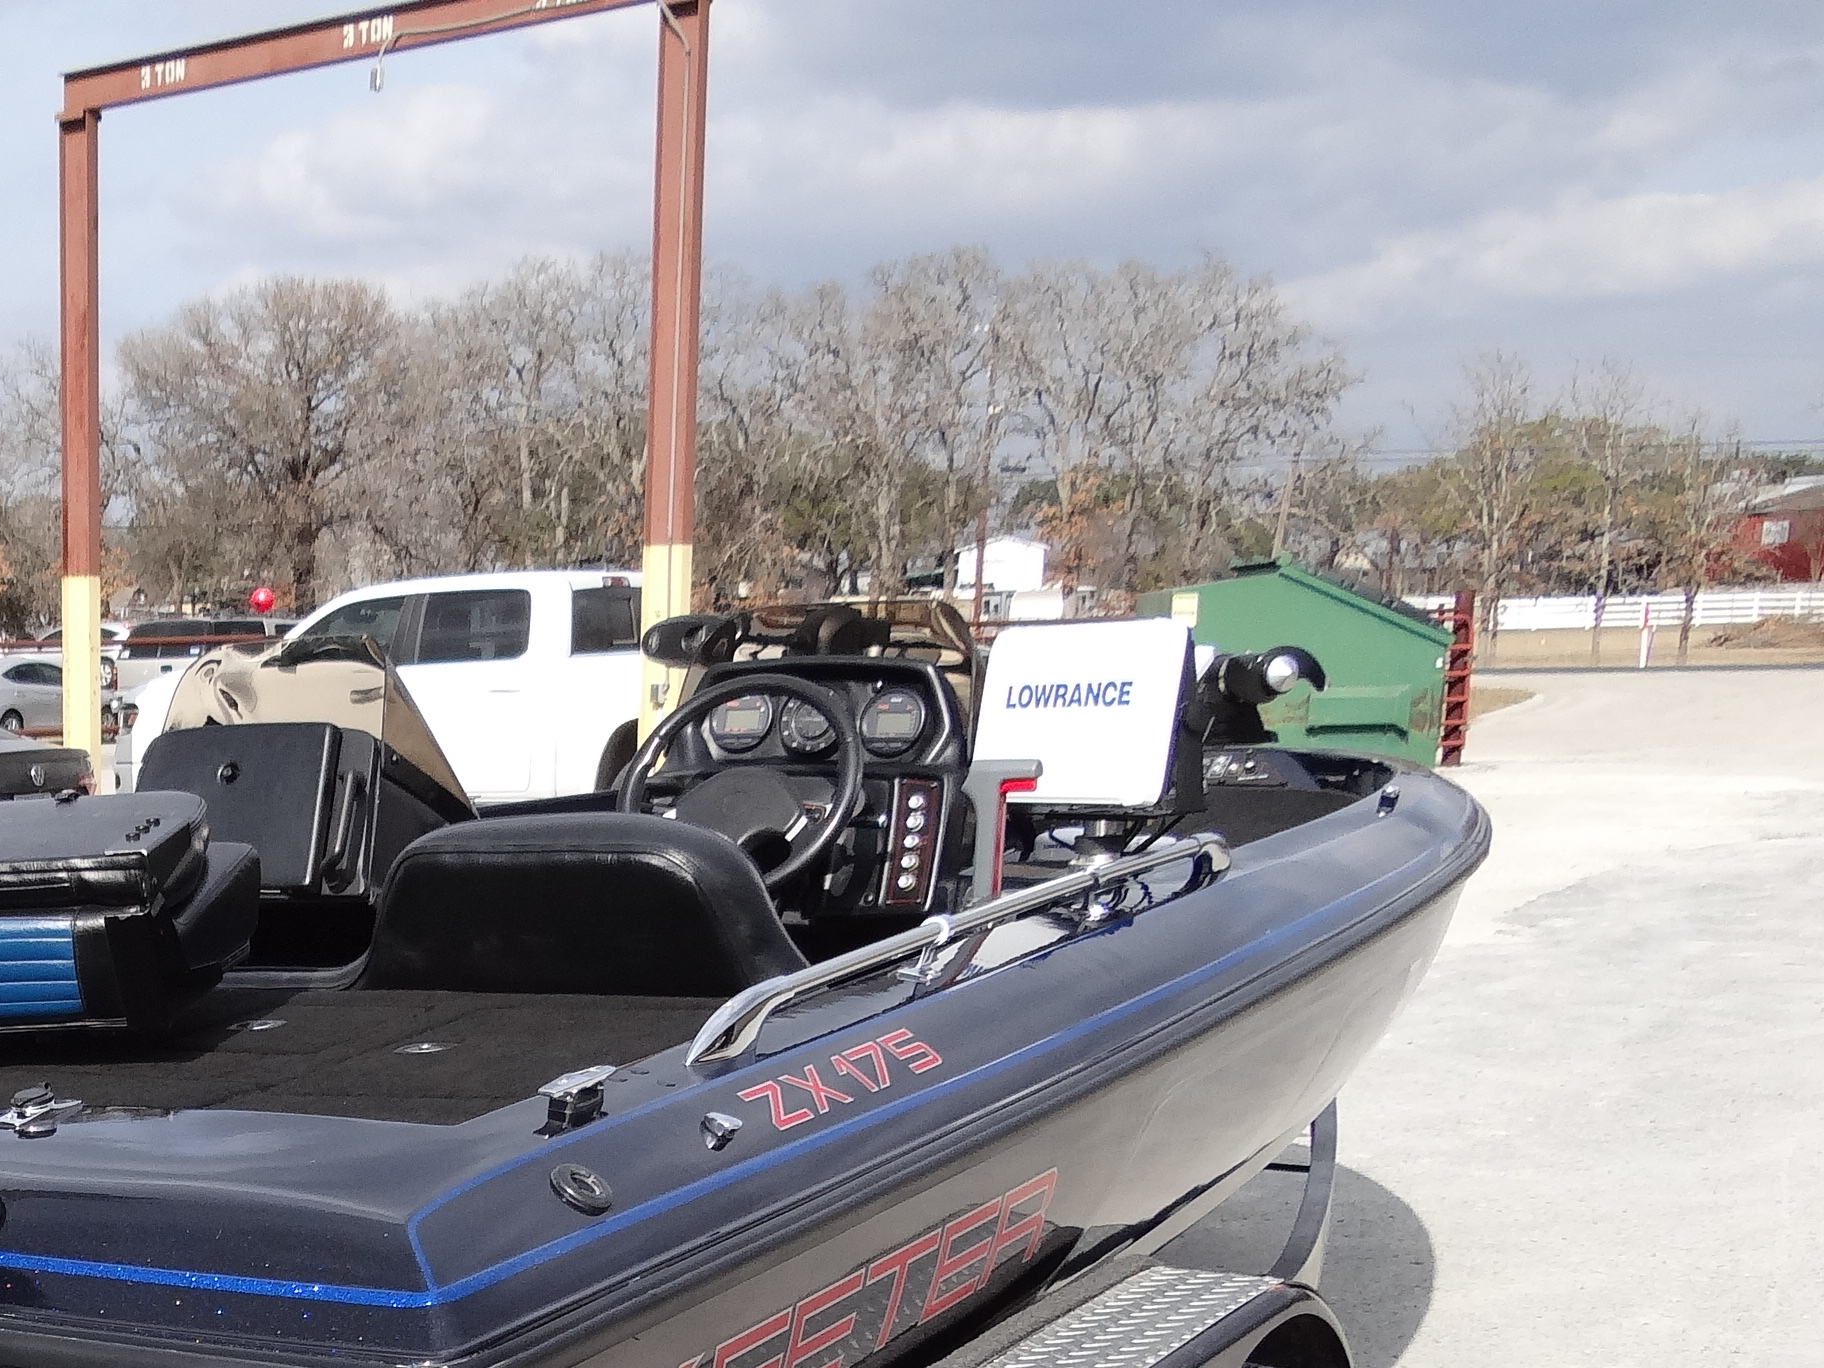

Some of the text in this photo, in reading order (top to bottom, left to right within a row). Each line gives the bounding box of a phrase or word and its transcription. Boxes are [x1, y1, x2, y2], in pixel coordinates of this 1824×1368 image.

[358, 14, 394, 49] TON
[155, 58, 187, 88] TON
[1005, 681, 1133, 710] LOWRANCE
